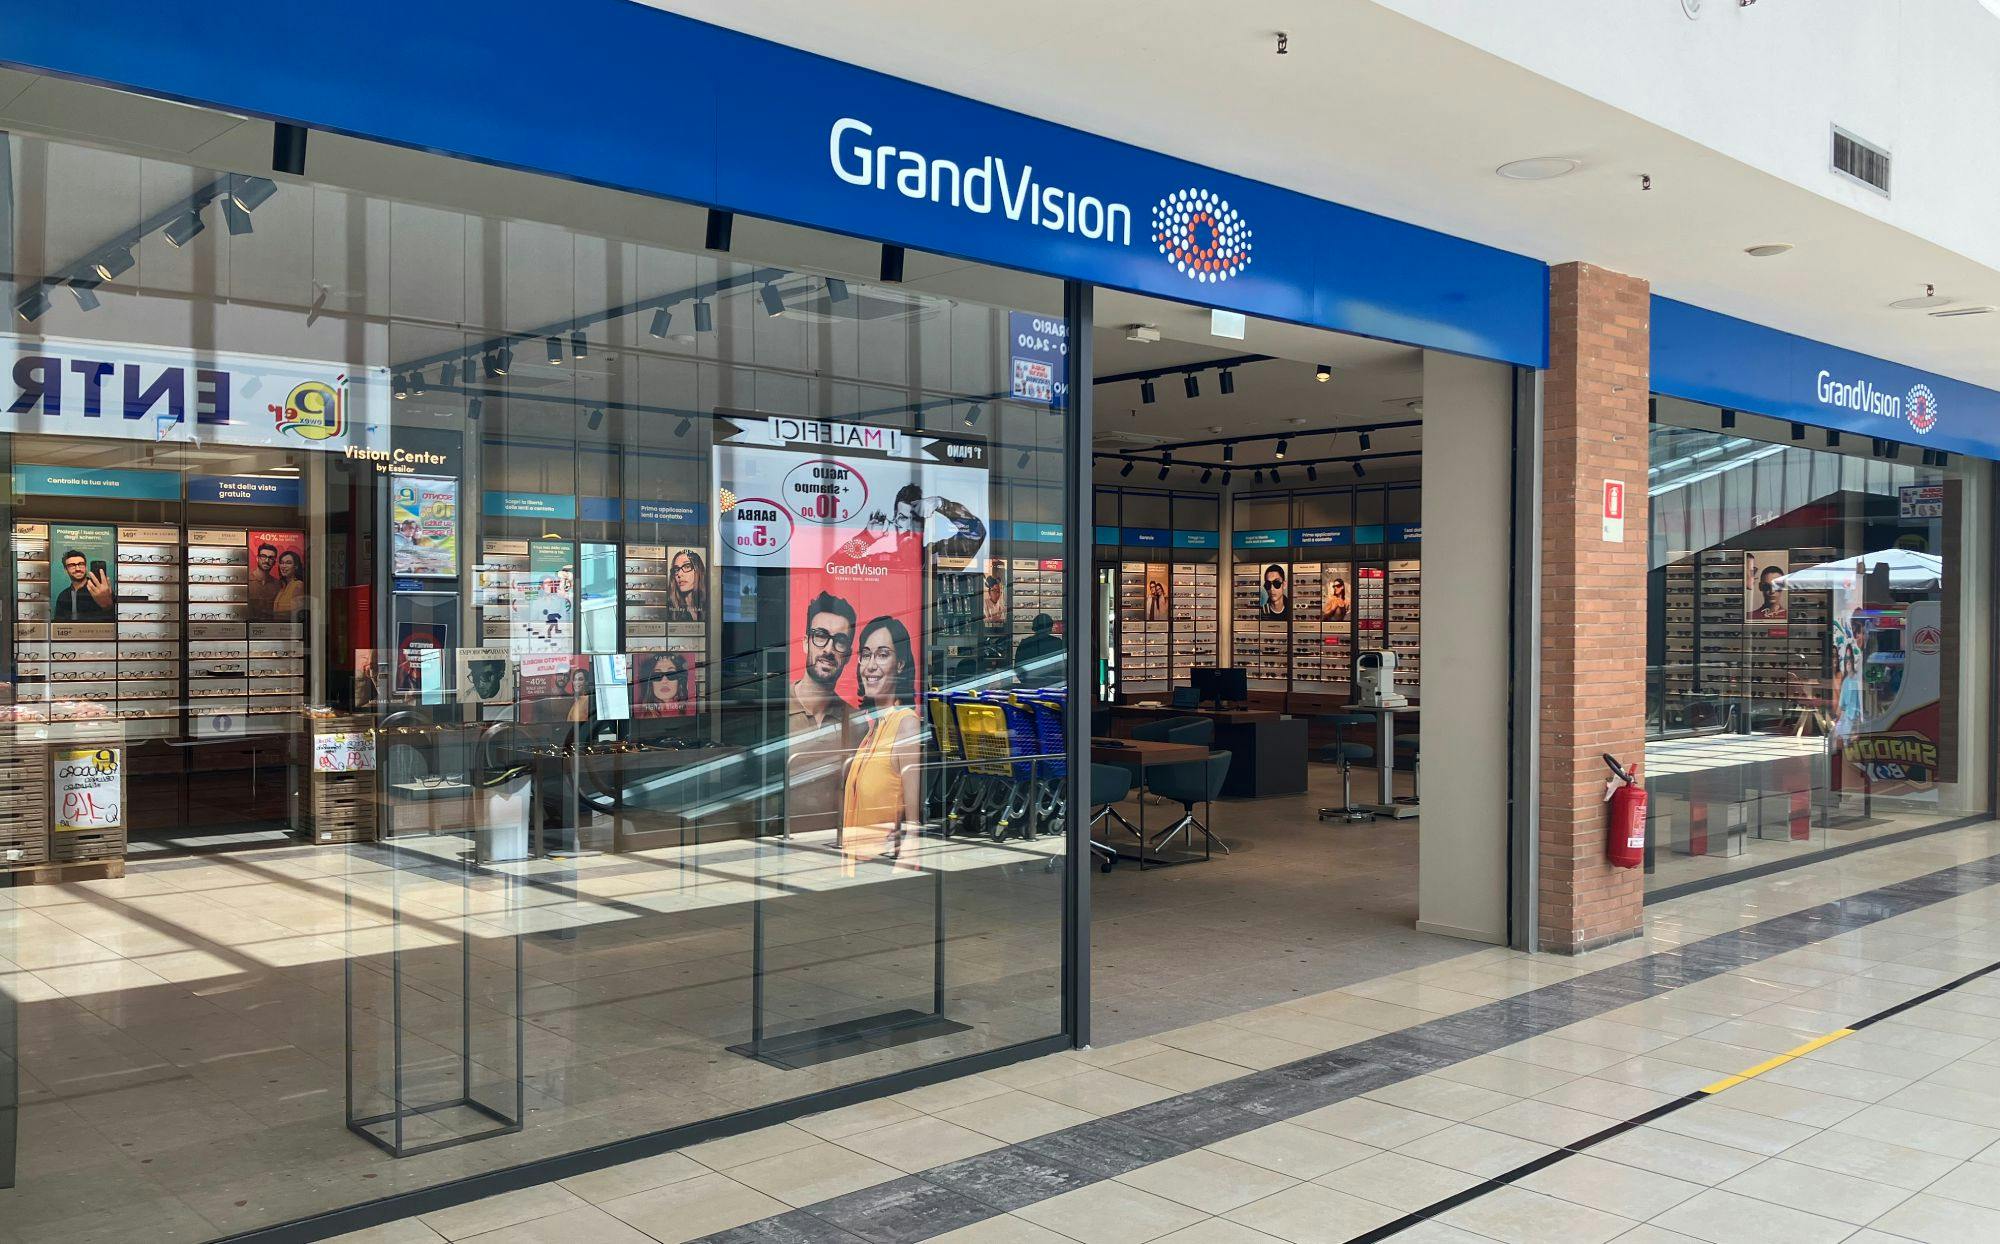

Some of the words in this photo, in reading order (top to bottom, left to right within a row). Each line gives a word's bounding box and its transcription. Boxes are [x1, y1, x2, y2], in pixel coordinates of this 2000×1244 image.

[829, 116, 1132, 246] GrandVision
[1817, 369, 1901, 419] GrandVision
[344, 445, 390, 461] Vision
[393, 448, 447, 465] Center
[376, 462, 386, 473] by
[47, 477, 80, 485] Controlla
[102, 479, 120, 487] vista
[219, 482, 236, 490] Test
[236, 483, 257, 491] della
[257, 484, 277, 492] vista
[218, 490, 251, 499] gratuito
[826, 562, 888, 576] GrandVision
